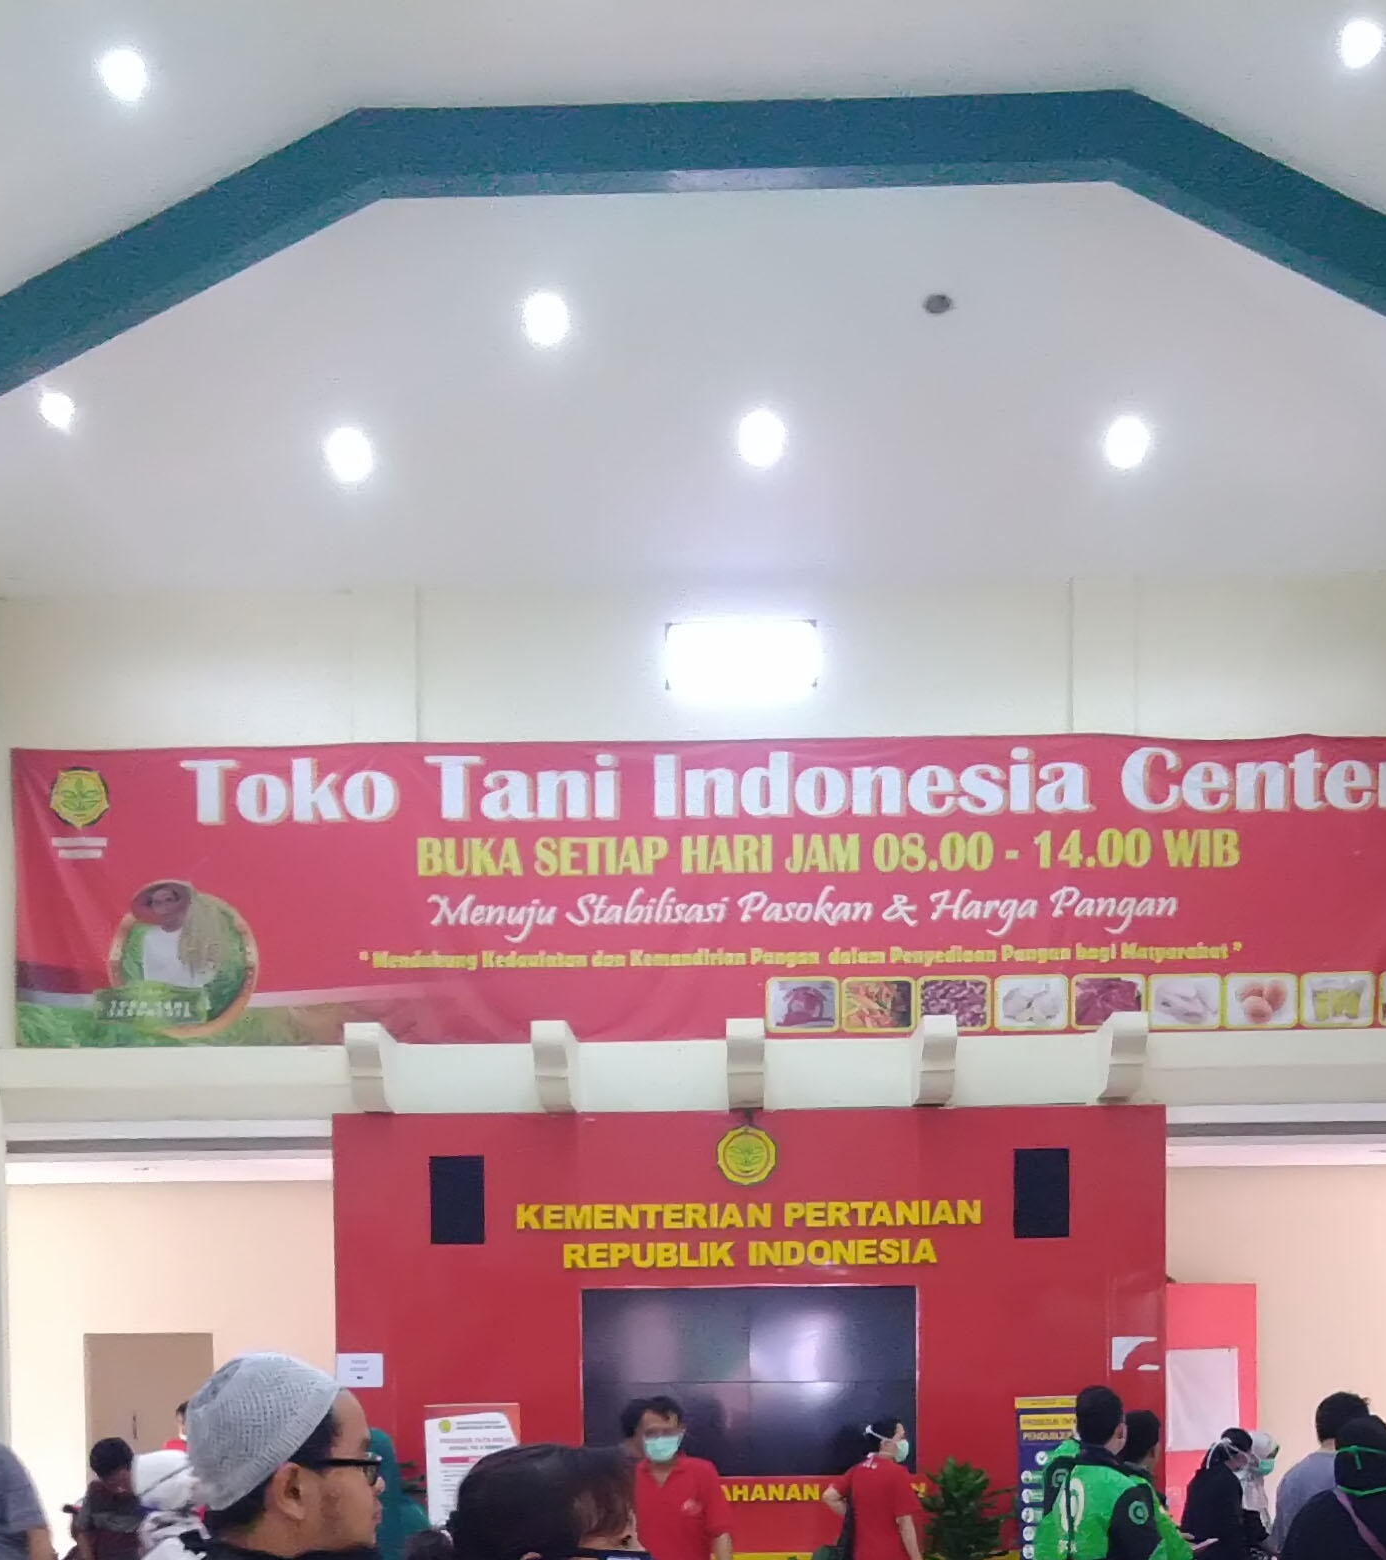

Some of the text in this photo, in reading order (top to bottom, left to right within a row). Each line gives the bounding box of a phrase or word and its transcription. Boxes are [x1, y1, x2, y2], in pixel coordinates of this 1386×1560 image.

[180, 758, 401, 826] Toko
[424, 753, 620, 821] Tani
[654, 746, 1096, 820] Indonesia
[417, 837, 523, 877] BUKA
[535, 836, 669, 876] SETIAP
[680, 833, 774, 875] HARI
[784, 833, 860, 873] JAM
[872, 831, 994, 873] 08.00
[1035, 829, 1153, 869] 14.00
[1163, 828, 1242, 868] WIB
[430, 886, 1179, 943] Menuju Stabilisasi Pasokan & Harga Pangan
[515, 1199, 982, 1231] KEMENTERIAN PERTANIAN
[562, 1237, 938, 1270] REPUBLIK INDONESIA
